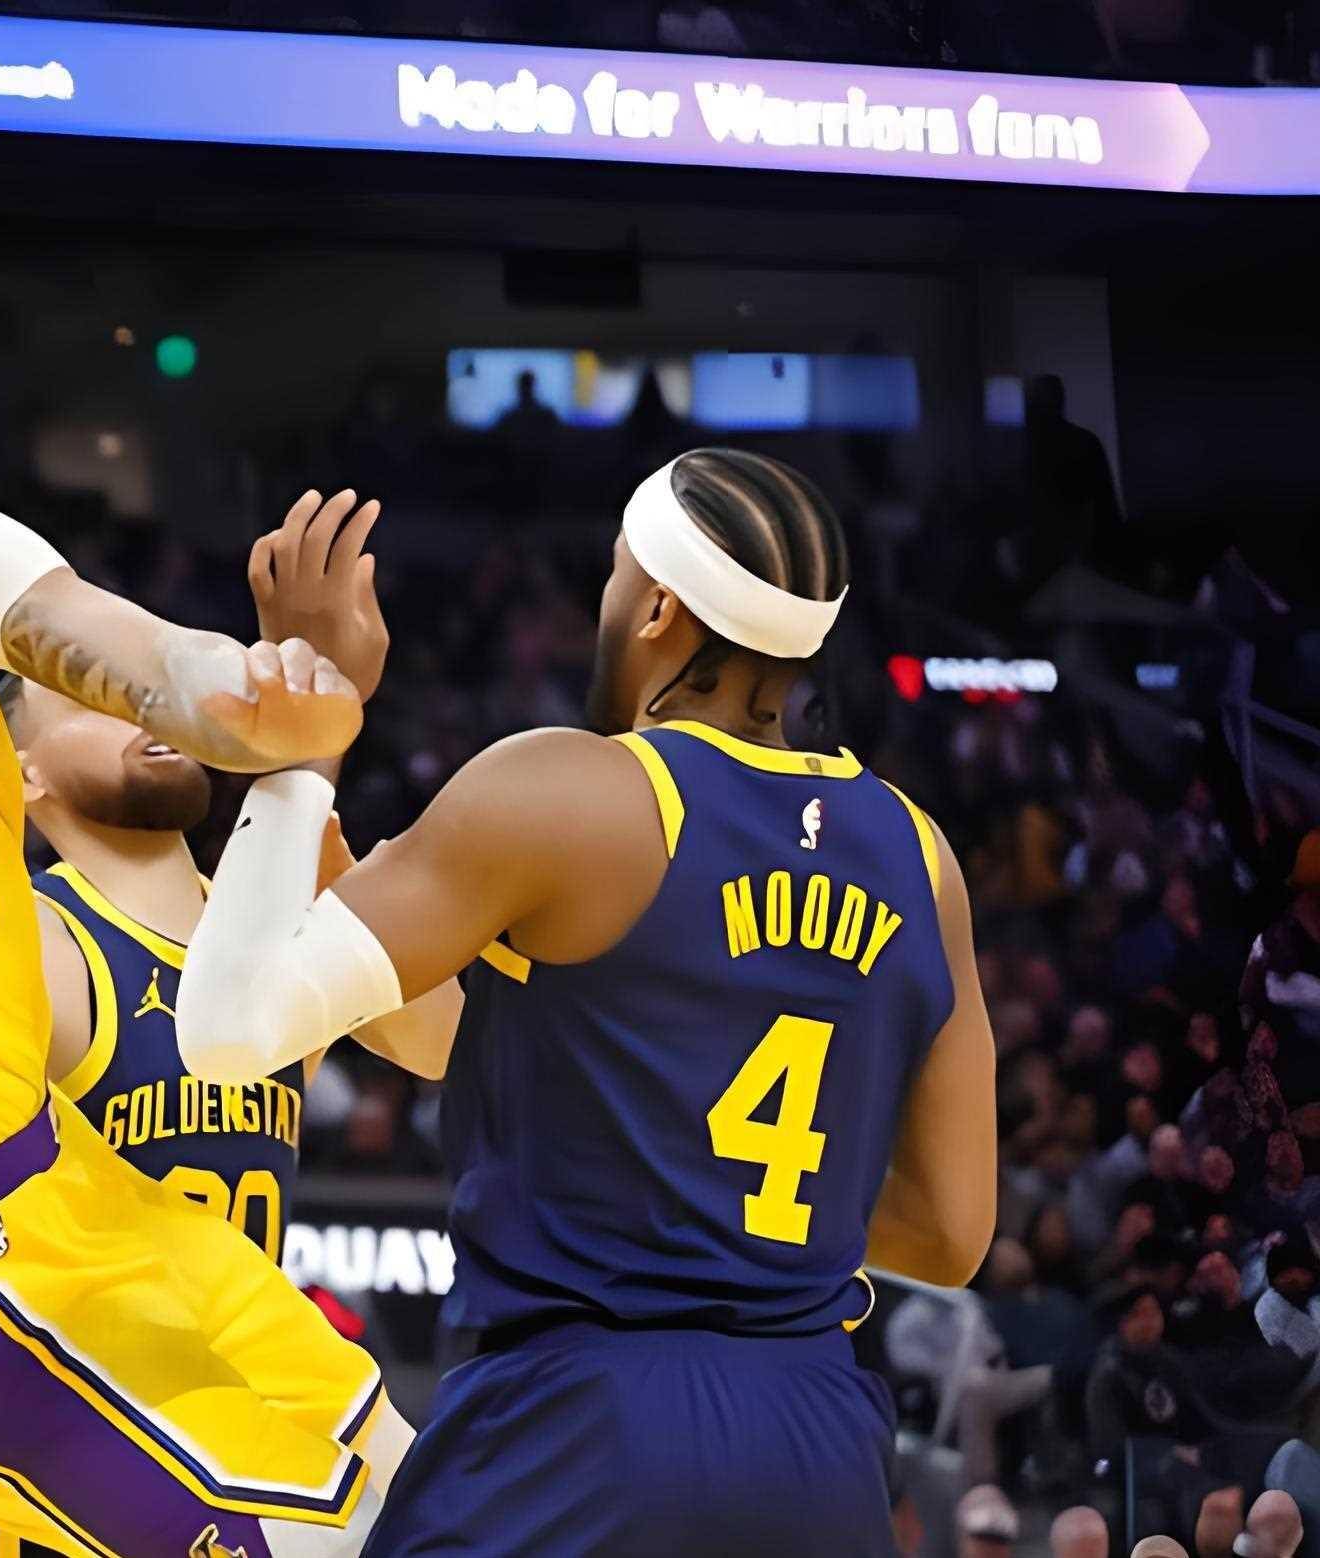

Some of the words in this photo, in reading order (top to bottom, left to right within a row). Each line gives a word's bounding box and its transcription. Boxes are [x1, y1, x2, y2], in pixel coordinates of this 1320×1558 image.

[398, 64, 576, 135] Made
[583, 71, 680, 138] for
[694, 81, 960, 155] Warriors
[968, 94, 1104, 165] fans
[721, 870, 903, 977] MOODY
[706, 1014, 835, 1246] 4
